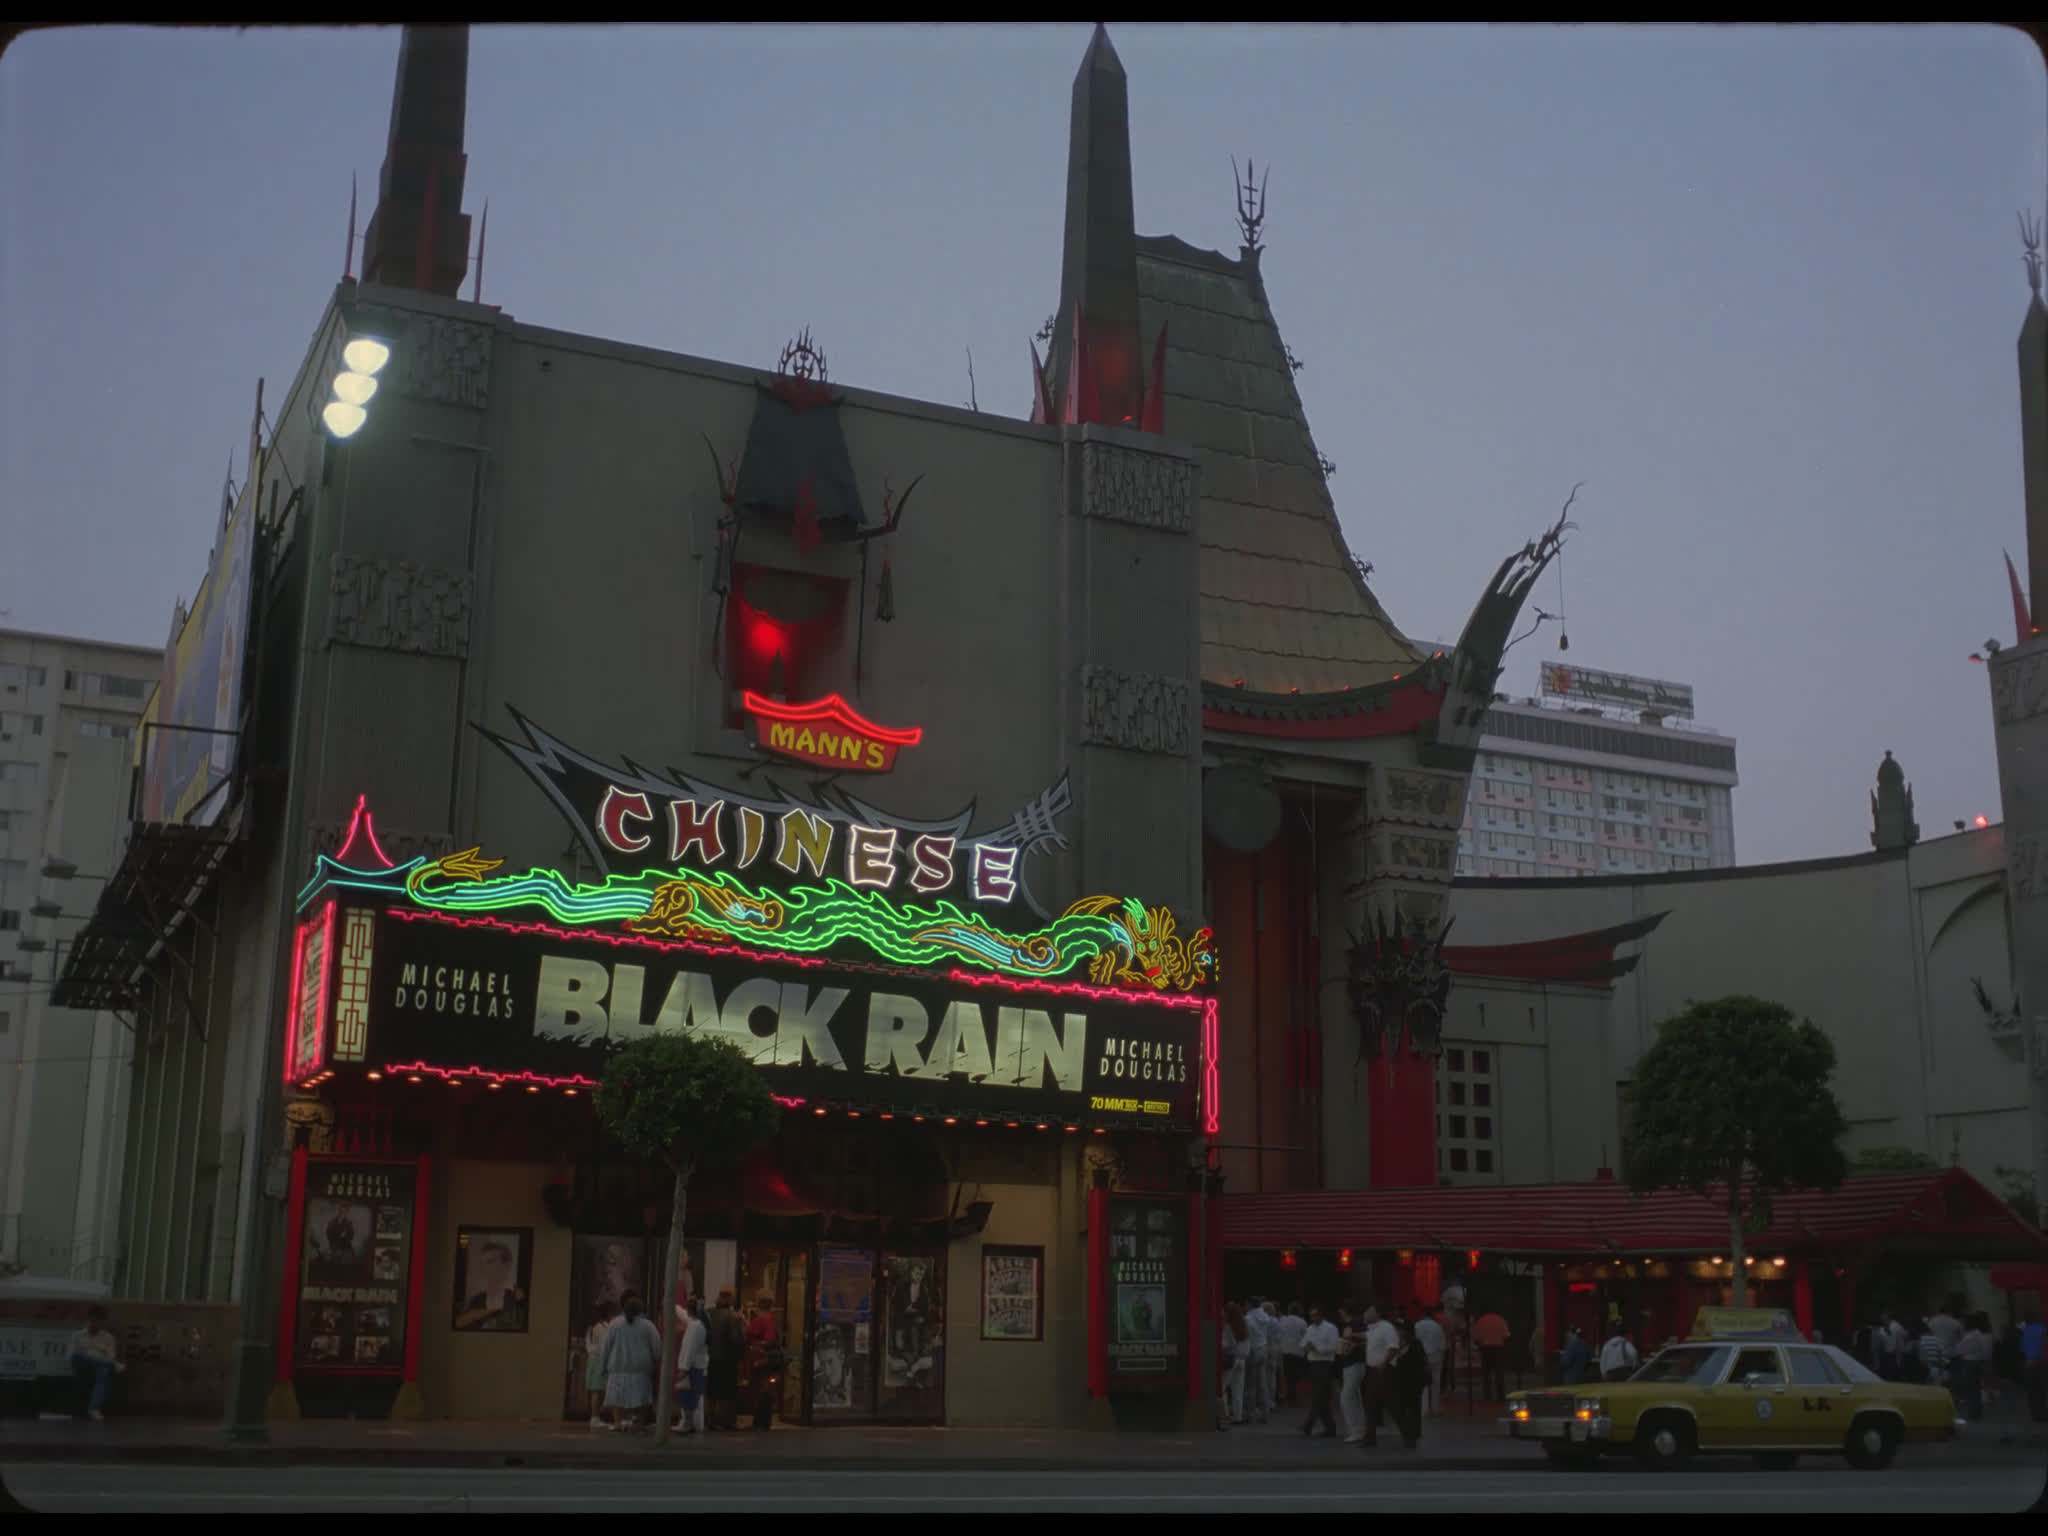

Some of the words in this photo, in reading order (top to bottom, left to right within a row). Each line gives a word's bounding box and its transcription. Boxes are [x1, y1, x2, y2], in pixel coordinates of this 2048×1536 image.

[770, 722, 885, 768] MANN'S
[599, 784, 1018, 902] CHINESE
[402, 962, 511, 996] MICHAEL
[394, 987, 514, 1020] DOUGLAS
[533, 954, 850, 1072] BLACK
[864, 991, 1087, 1093] RAIN
[1105, 1037, 1185, 1062] MICHAEL
[1100, 1057, 1187, 1083] DOUGLAS
